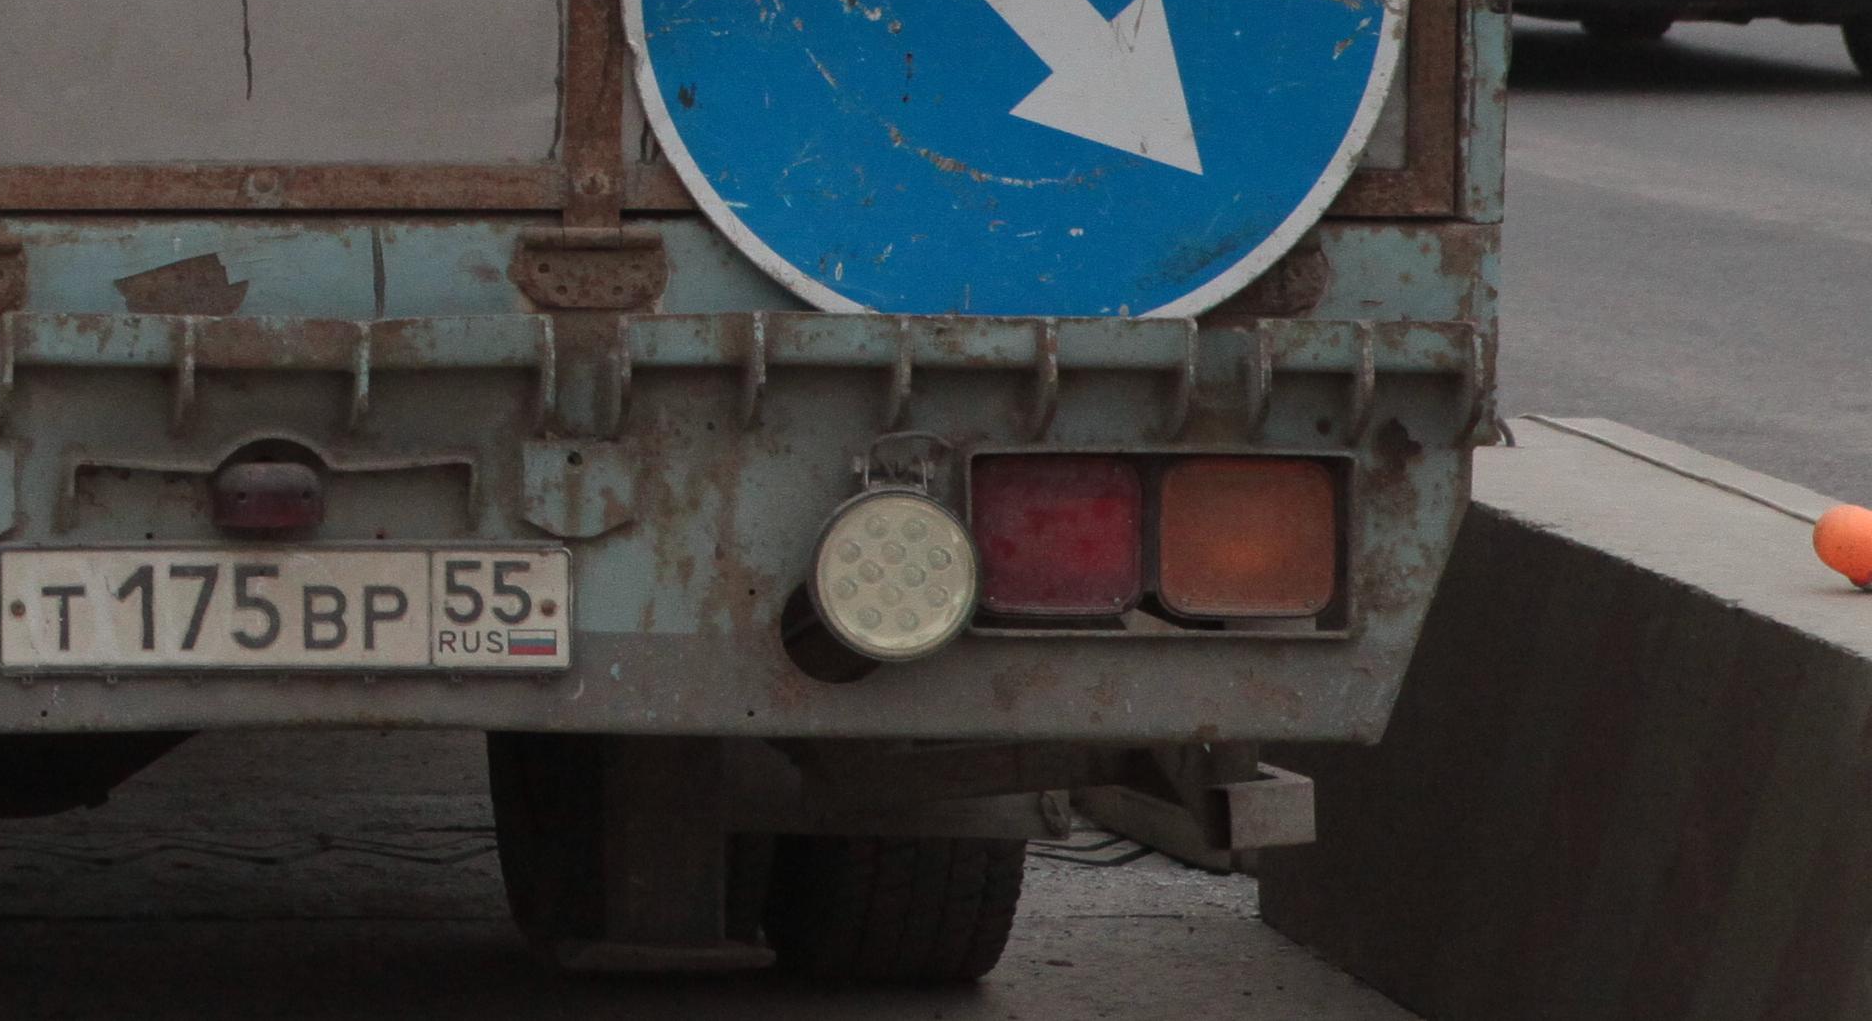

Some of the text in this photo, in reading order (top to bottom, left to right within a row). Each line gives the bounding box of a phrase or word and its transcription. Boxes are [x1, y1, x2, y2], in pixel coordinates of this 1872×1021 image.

[41, 560, 533, 651] Т175ВР 55
[437, 629, 505, 654] RUS
